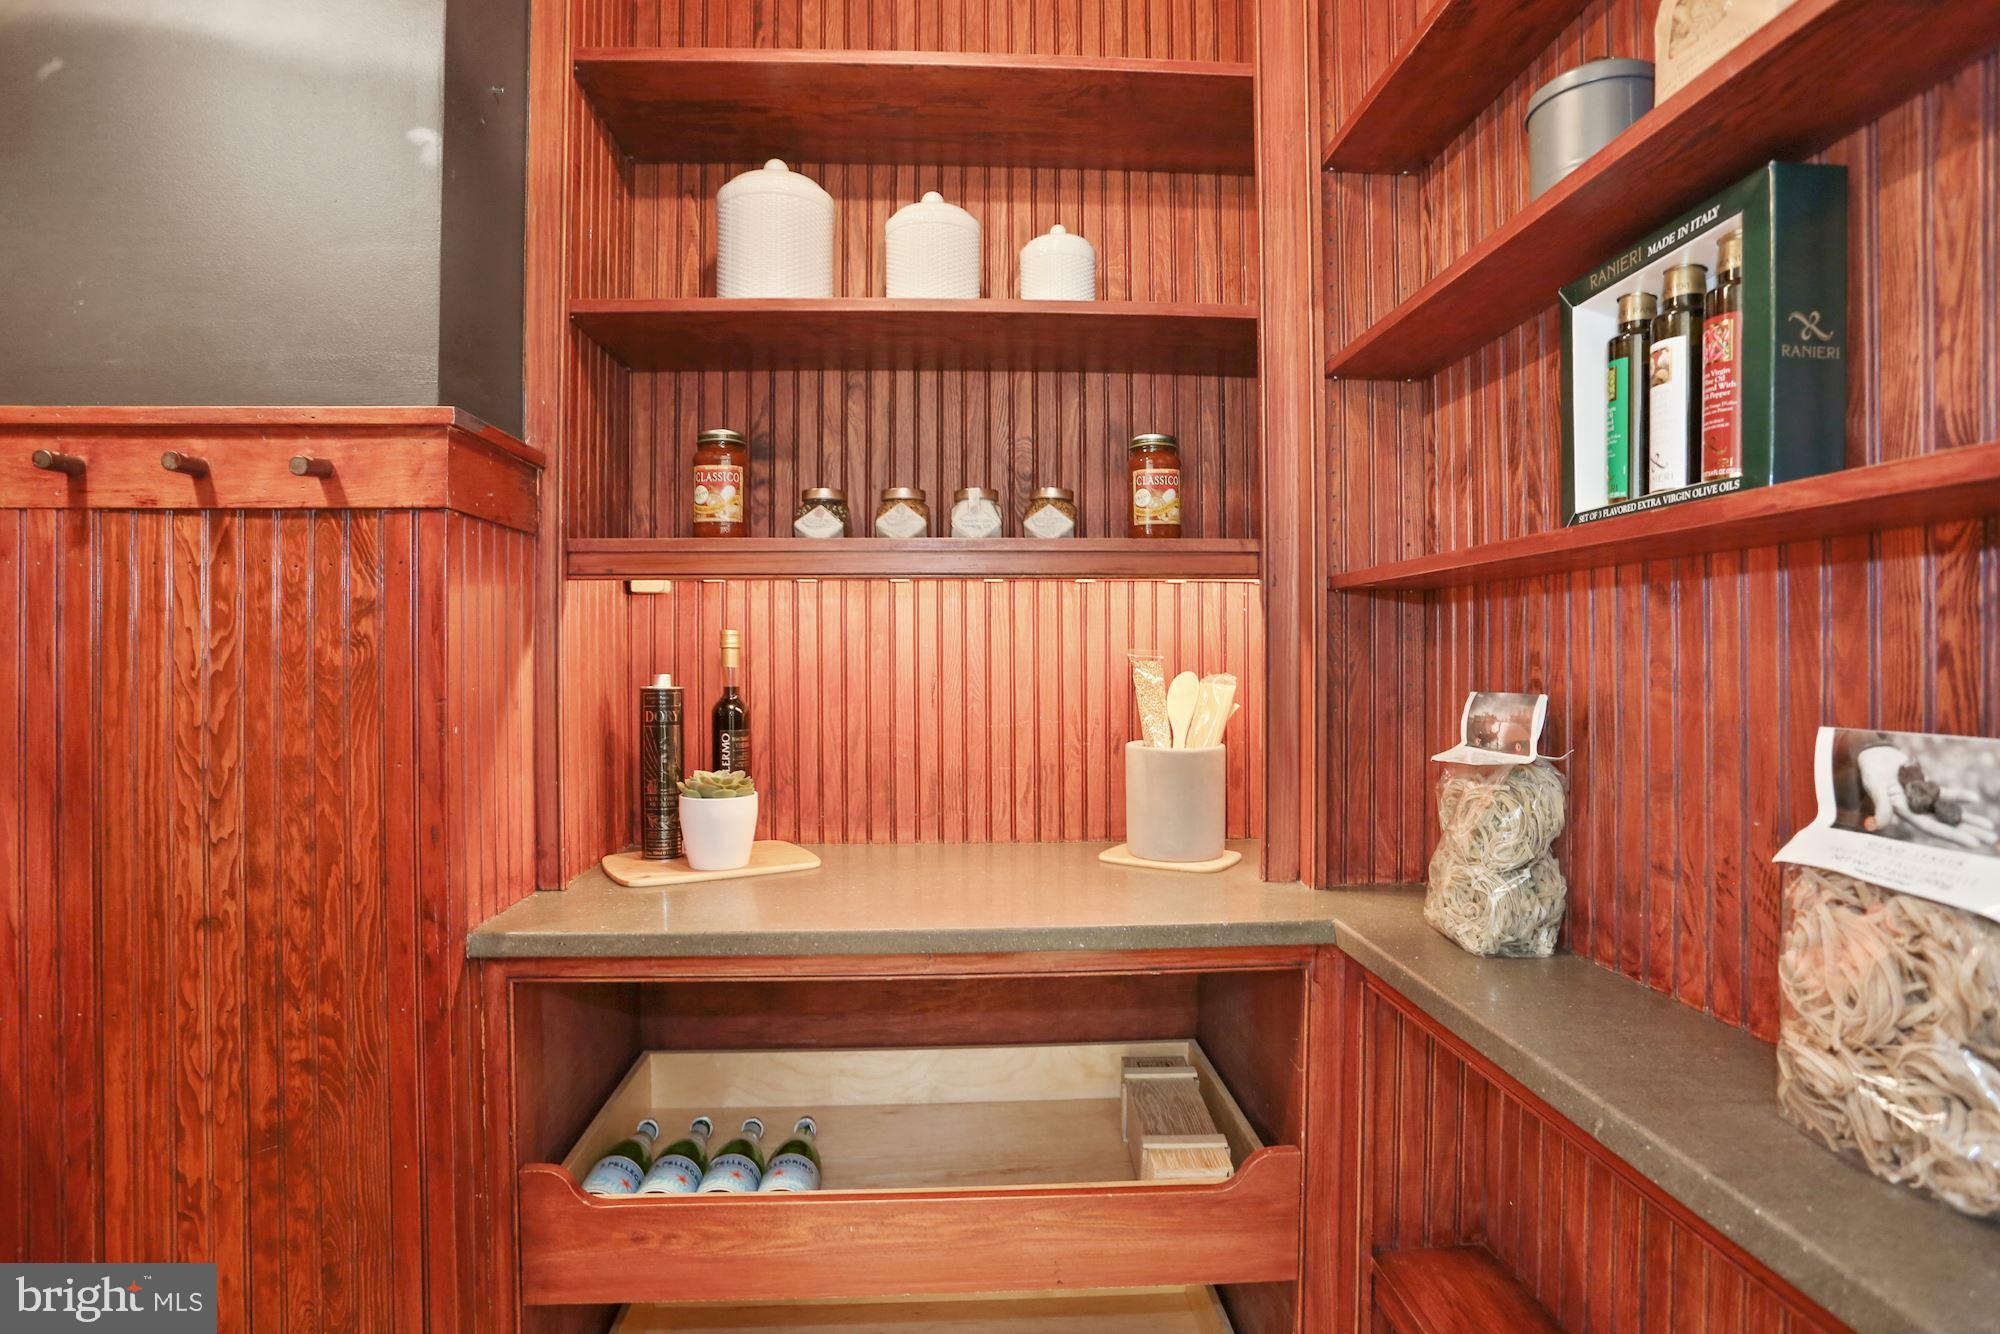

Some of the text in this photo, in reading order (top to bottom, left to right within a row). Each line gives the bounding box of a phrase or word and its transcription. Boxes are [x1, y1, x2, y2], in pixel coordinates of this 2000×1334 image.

[1589, 204, 1721, 291] RANIERI MADE IN ITALY
[1781, 344, 1840, 360] RANIERI
[695, 471, 740, 483] CLASSICO
[1136, 475, 1179, 486] CLASSICO
[1578, 513, 1590, 524] SET
[1589, 511, 1598, 520] OF
[1602, 502, 1637, 518] FLAVORED
[1637, 497, 1662, 511] EXTRA
[1662, 488, 1692, 506] VIRGIN
[1692, 483, 1719, 499] OLIVE
[1718, 479, 1741, 493] OILS
